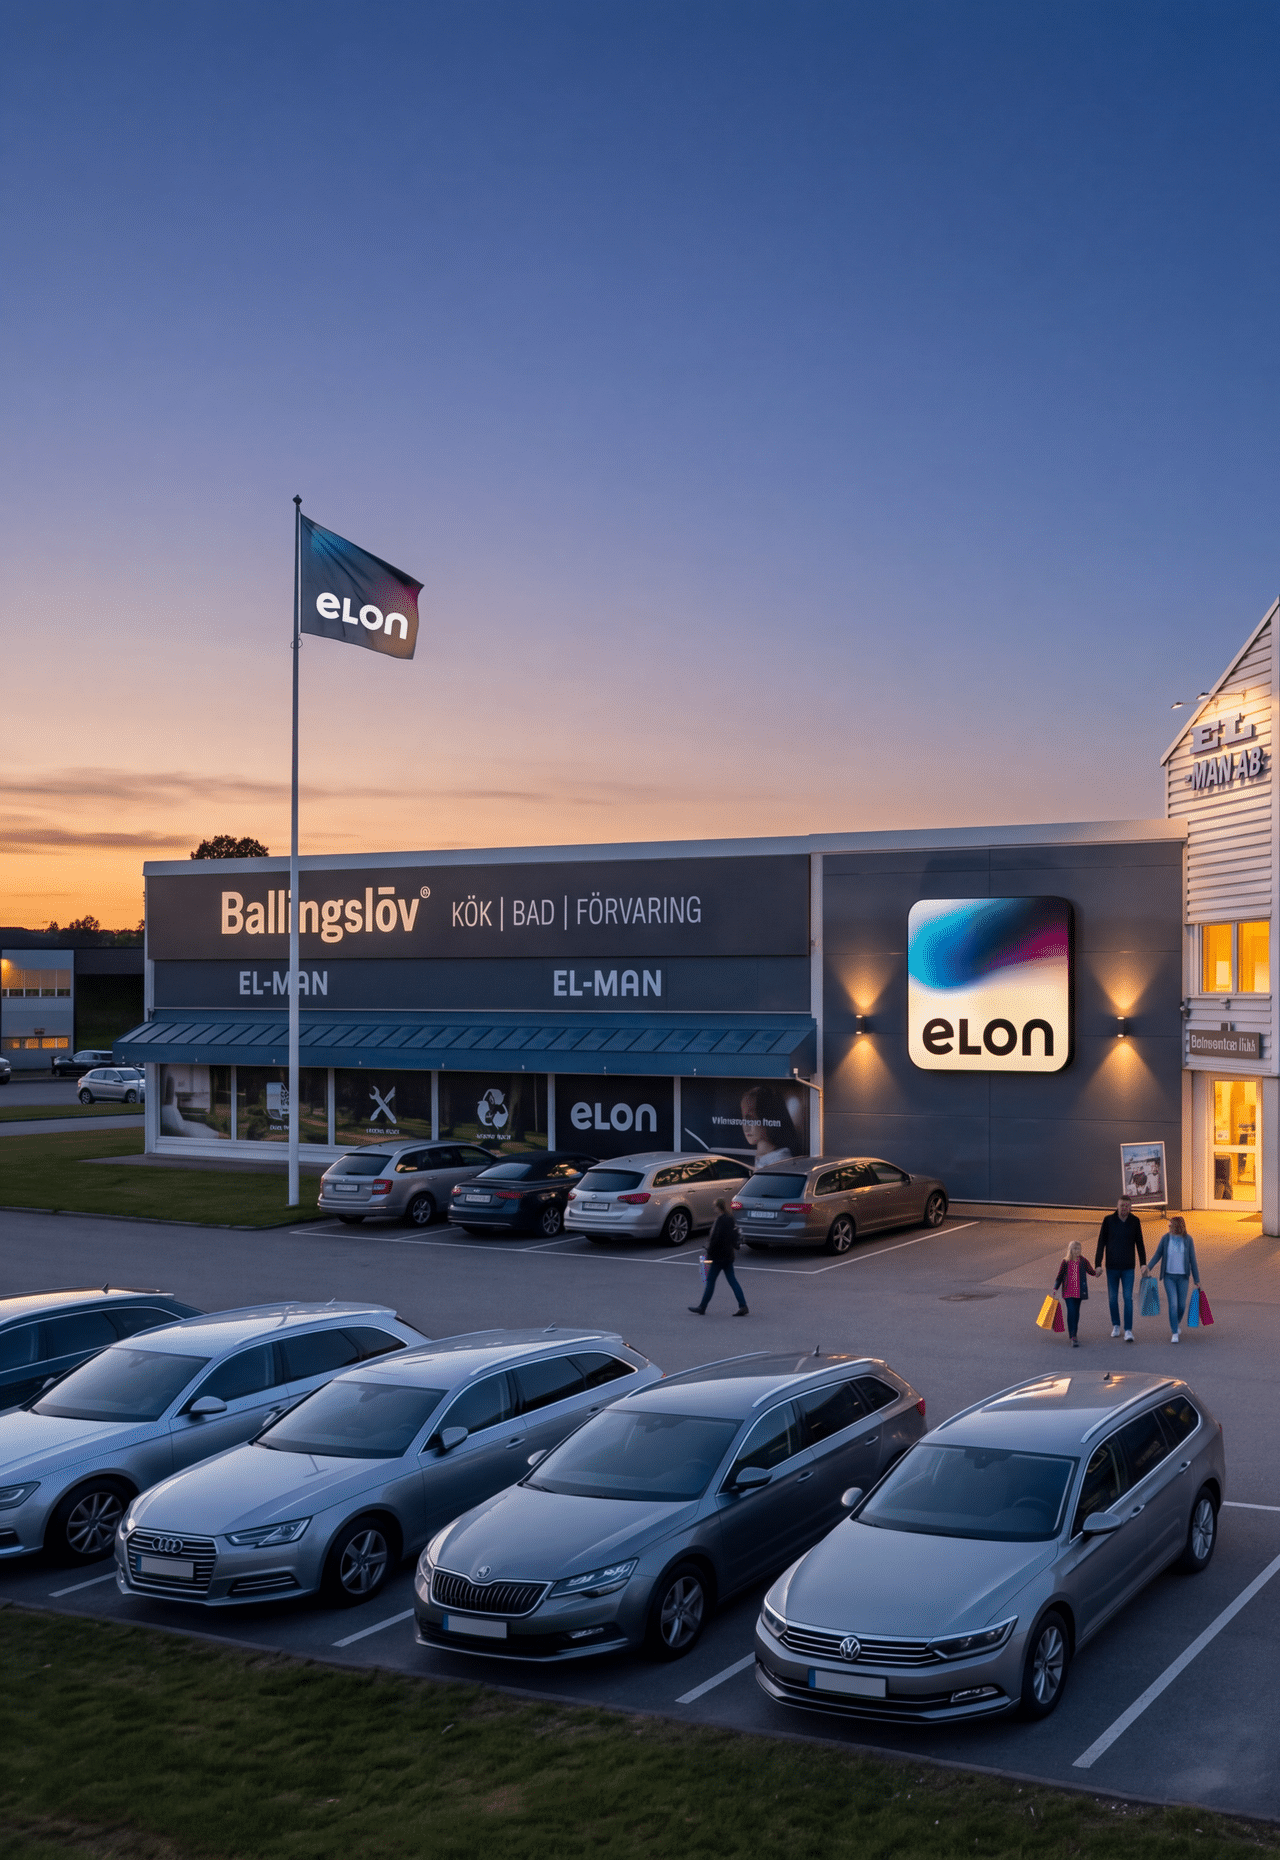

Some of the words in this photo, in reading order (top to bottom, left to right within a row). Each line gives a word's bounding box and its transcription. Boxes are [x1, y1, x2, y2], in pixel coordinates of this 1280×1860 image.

[1190, 713, 1256, 754] EL
[1236, 747, 1264, 779] AB
[452, 895, 493, 927] KÖK
[513, 899, 555, 926] BAD
[577, 892, 702, 925] FÖRVARING
[239, 971, 328, 995] EL-MAN
[553, 969, 662, 996] EL-MAN
